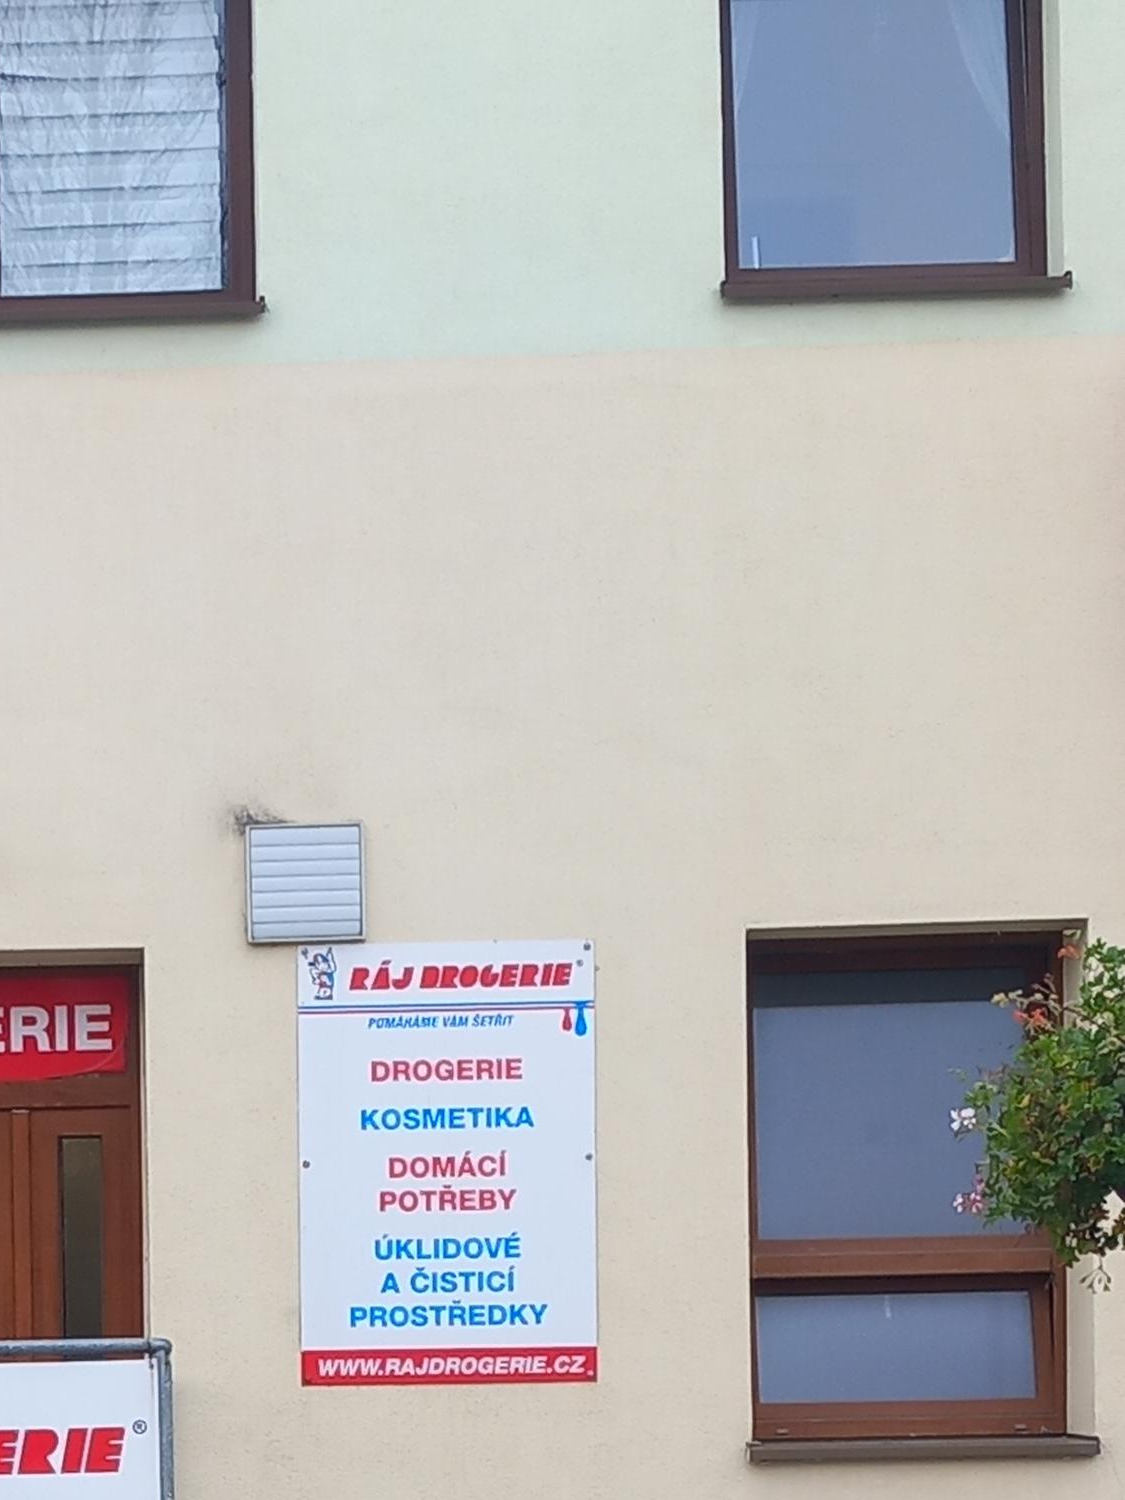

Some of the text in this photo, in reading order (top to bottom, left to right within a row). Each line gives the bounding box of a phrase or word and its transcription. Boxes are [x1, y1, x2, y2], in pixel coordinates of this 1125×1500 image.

[349, 960, 573, 991] RÁJ DROGERIE
[442, 1013, 469, 1027] VÁM
[370, 1058, 523, 1082] DROGERIE
[360, 1107, 535, 1130] KOSMETIKA
[388, 1151, 507, 1179] DOMÁCÍ
[379, 1184, 517, 1212] POTŘEBY
[374, 1233, 521, 1261] ÚKLIDOVÉ
[381, 1266, 515, 1294] A ČISTICÍ
[350, 1299, 548, 1328] PROSTŘEDKY
[318, 1356, 586, 1376] WWW.RAJDROGERIE.CZ
